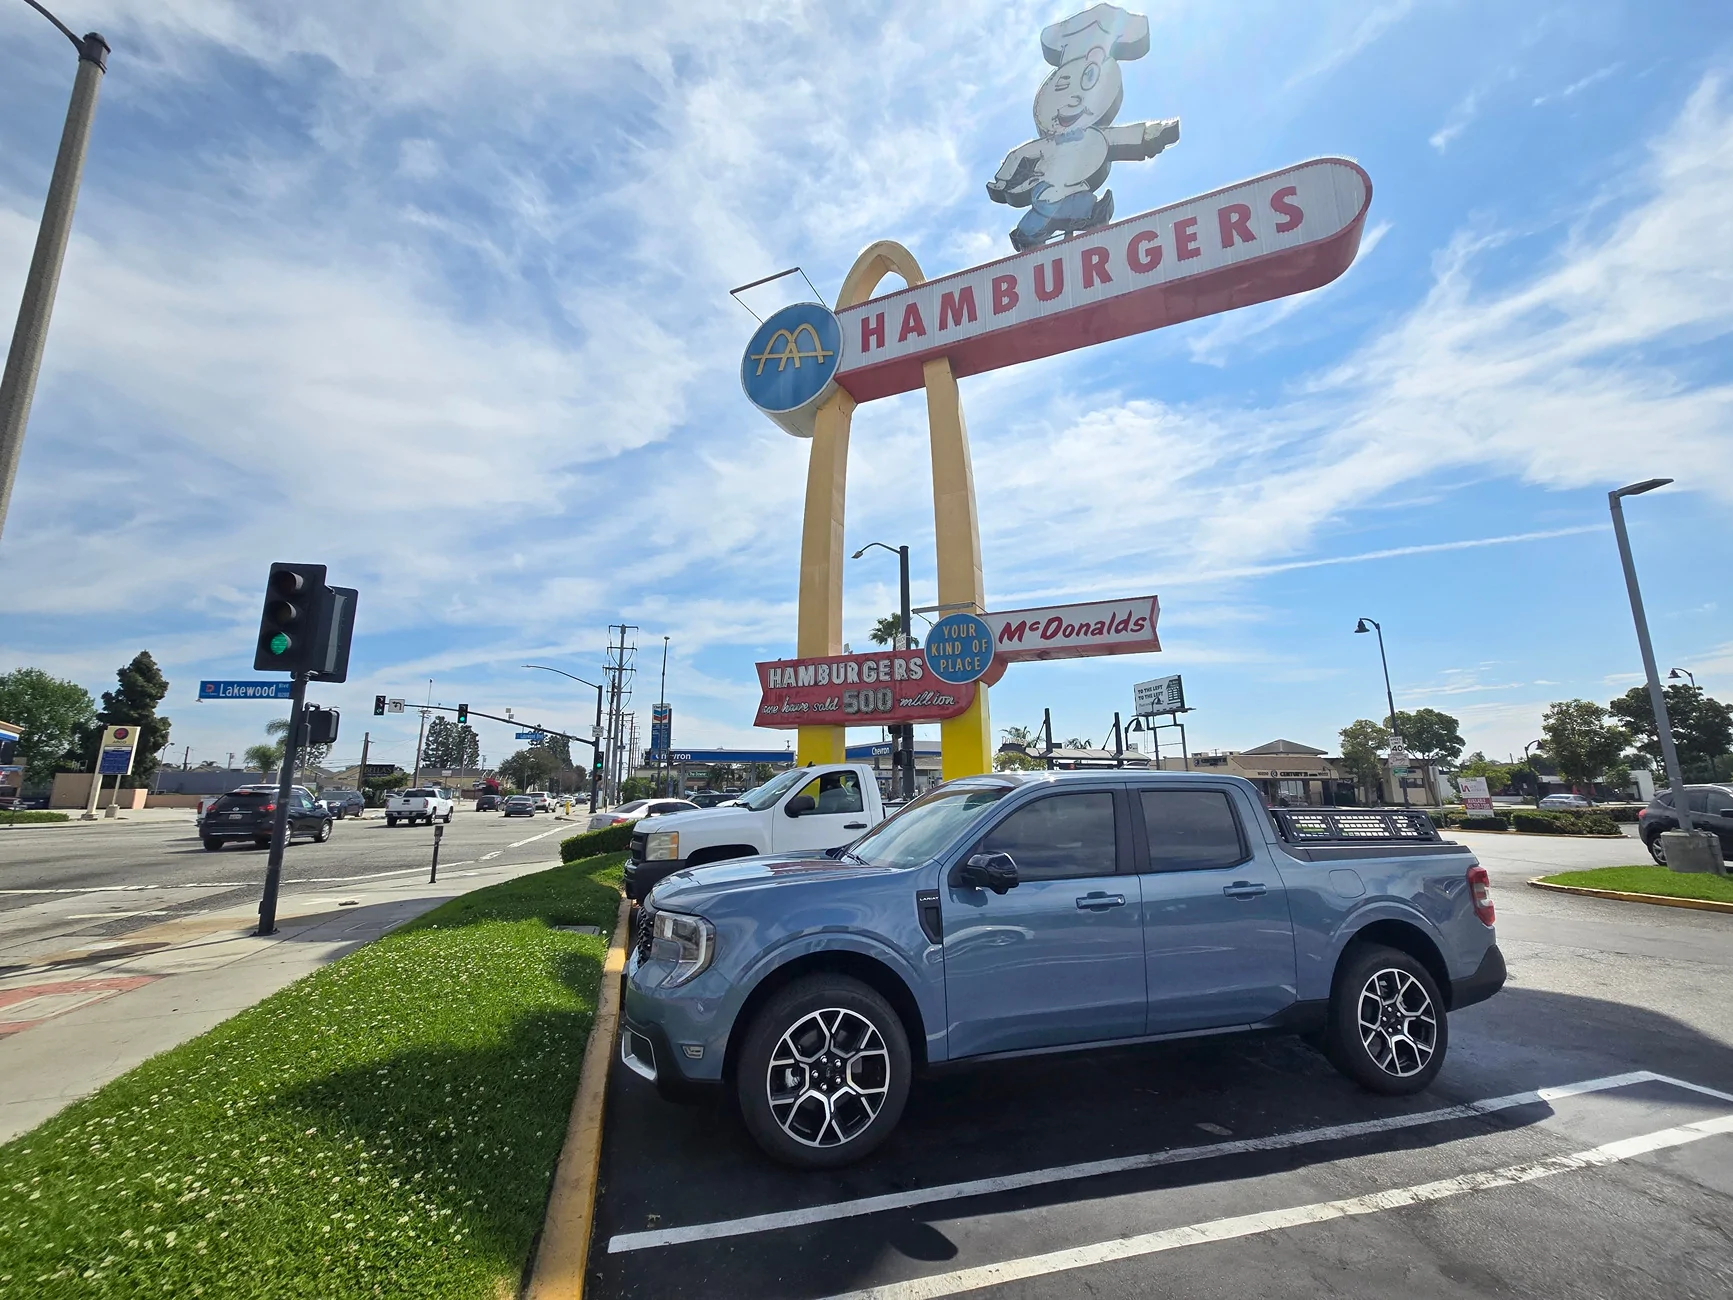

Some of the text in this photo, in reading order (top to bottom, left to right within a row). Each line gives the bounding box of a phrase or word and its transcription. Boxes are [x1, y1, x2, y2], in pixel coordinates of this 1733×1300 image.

[861, 185, 1305, 353] HAMBURGERS
[942, 624, 976, 640] YOUR
[998, 609, 1147, 645] McDonalds
[931, 639, 988, 657] KIND OF
[768, 656, 924, 690] HAMBURGERS
[940, 657, 981, 673] PLACE
[220, 683, 277, 697] Lakewood
[763, 686, 956, 715] we have sold 500 million
[871, 747, 890, 756] Chevron
